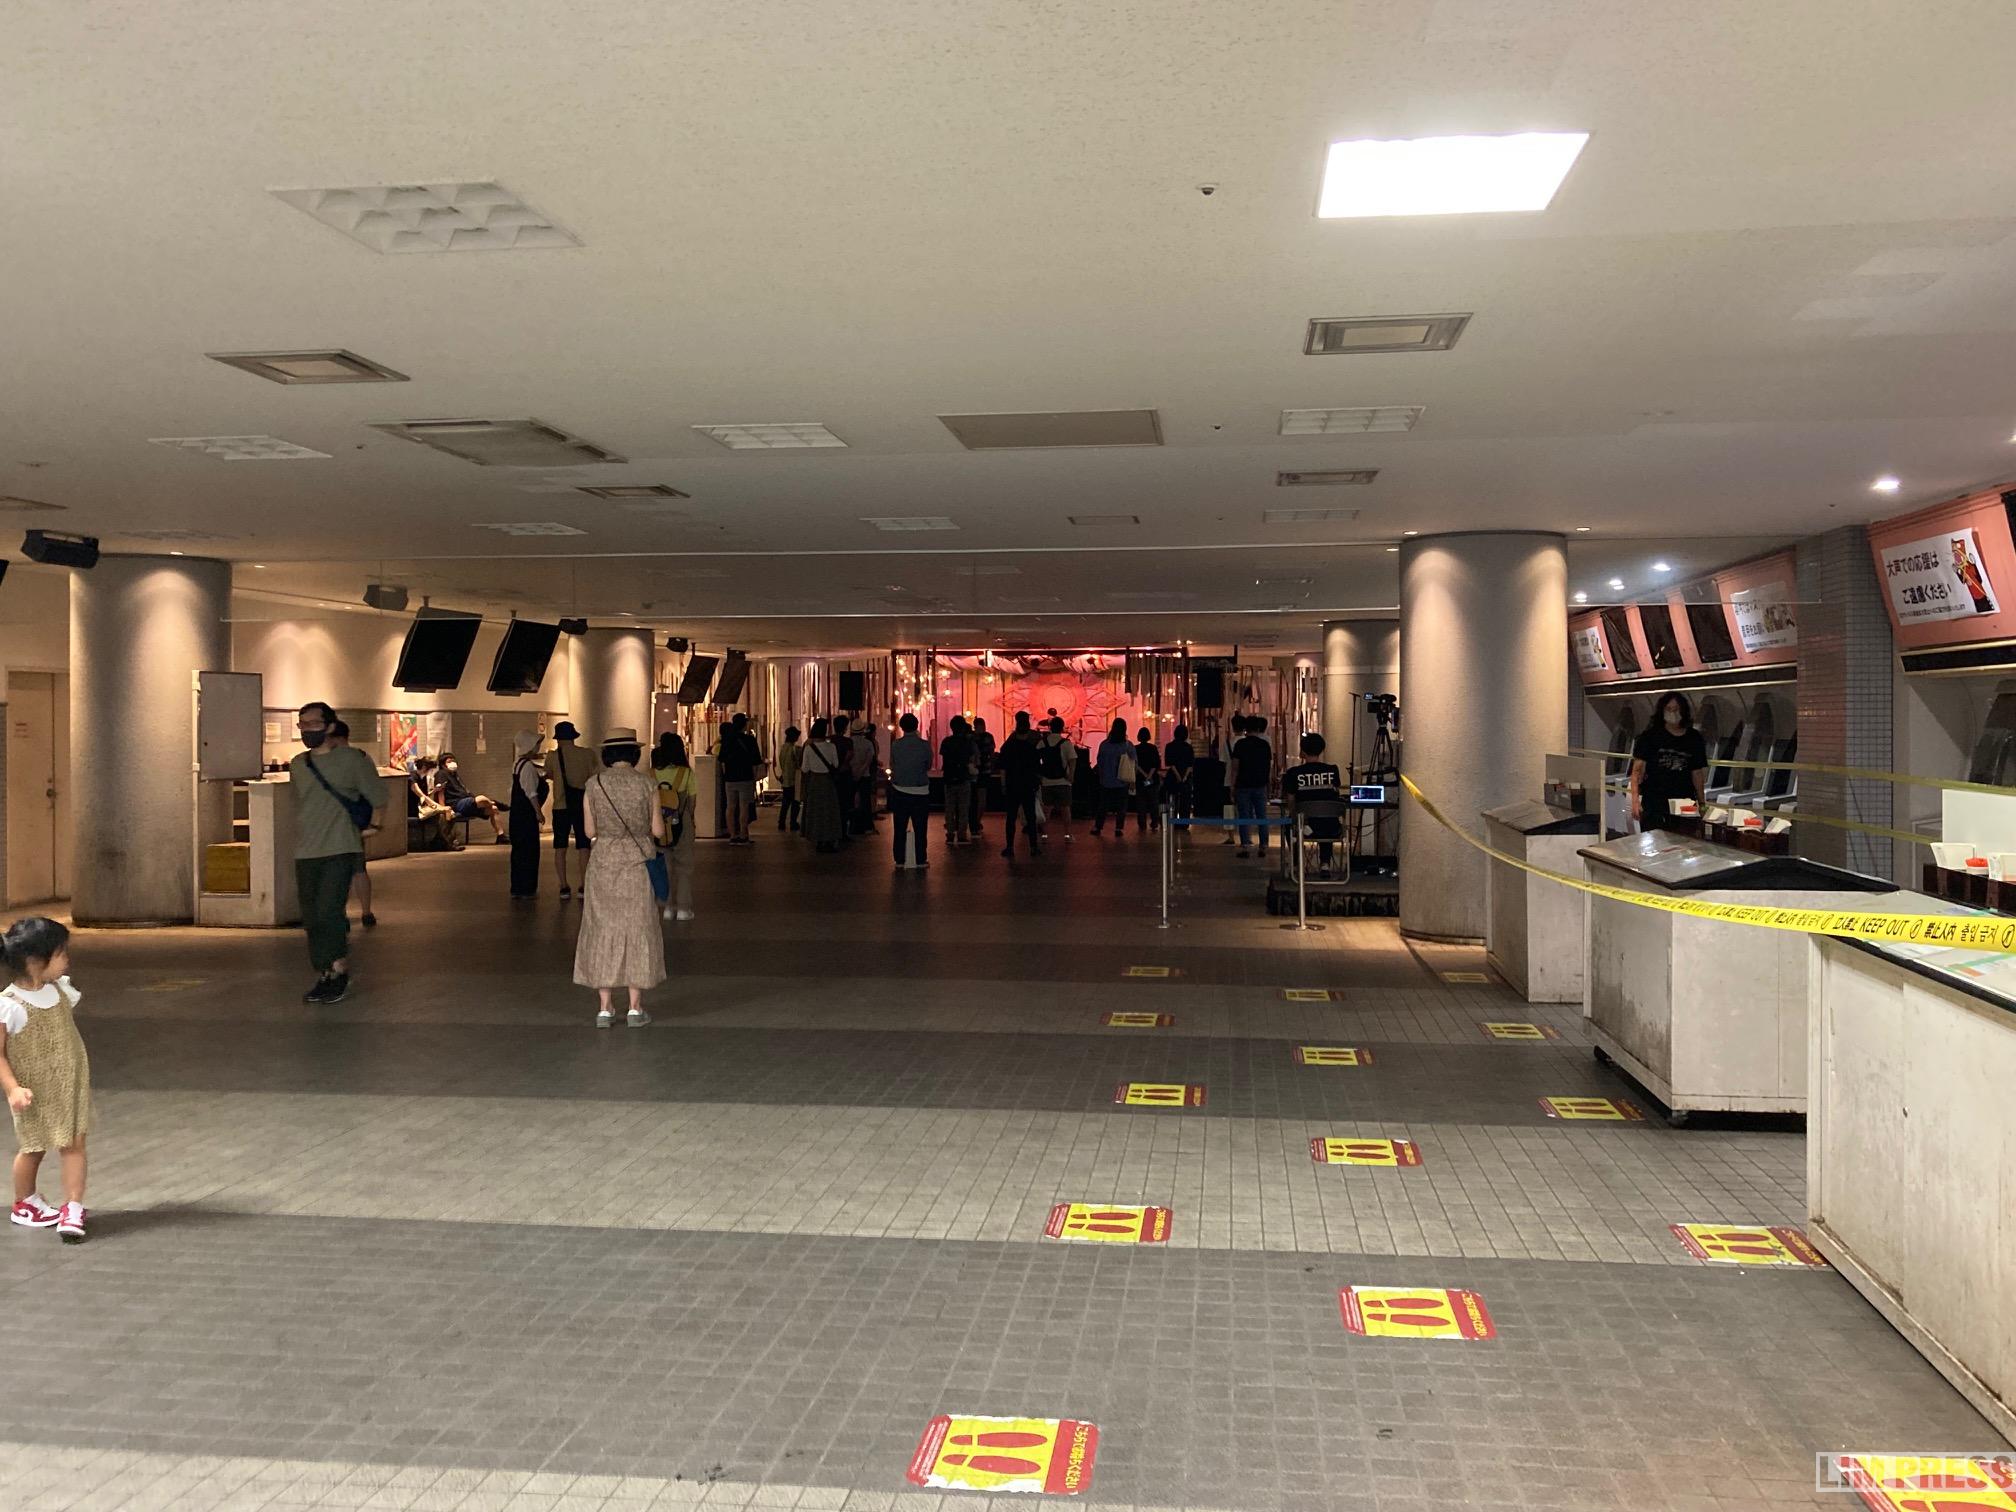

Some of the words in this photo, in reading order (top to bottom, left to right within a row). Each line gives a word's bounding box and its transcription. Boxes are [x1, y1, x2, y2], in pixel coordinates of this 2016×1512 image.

[1297, 772, 1335, 787] STAFF
[1859, 917, 1887, 934] KEEP
[1886, 919, 1909, 936] OUT
